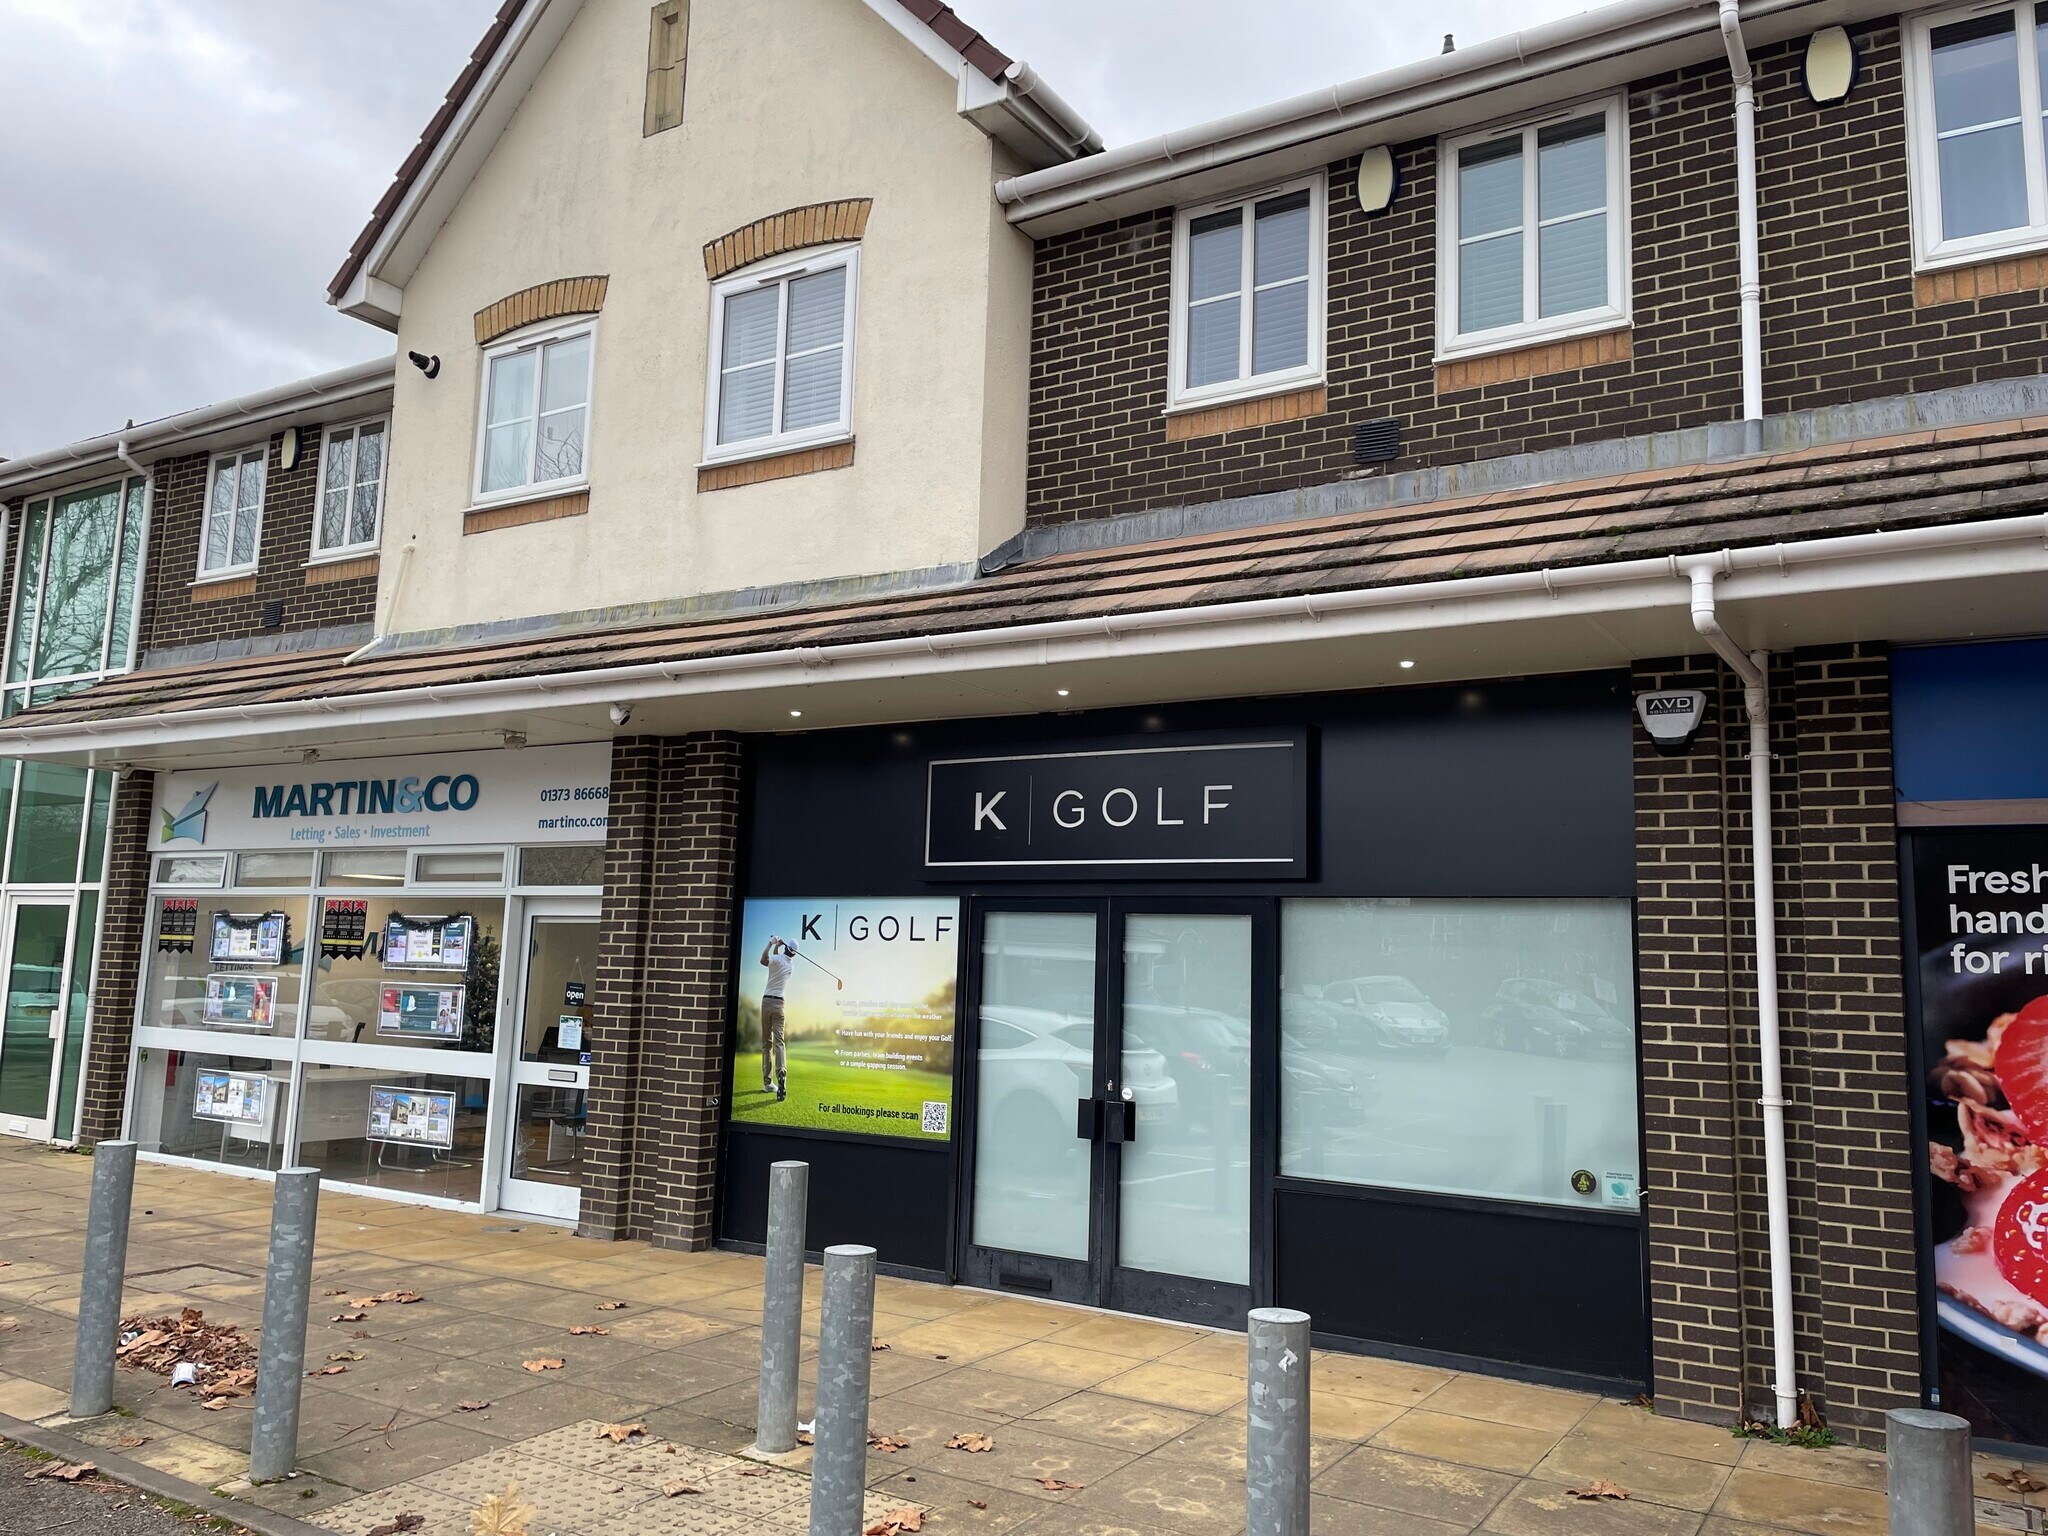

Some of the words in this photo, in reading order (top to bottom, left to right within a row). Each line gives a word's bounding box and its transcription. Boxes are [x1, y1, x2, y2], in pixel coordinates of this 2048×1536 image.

[1650, 698, 1691, 710] AVD
[251, 773, 480, 819] MARTIN&CO
[540, 788, 571, 802] 01373
[574, 786, 609, 801] 86668
[974, 790, 1007, 831] K
[1053, 784, 1233, 828] GOLF
[290, 826, 326, 843] Letting
[334, 825, 361, 839] Sales
[370, 824, 431, 838] Investment
[1947, 863, 2048, 894] Fresh
[1949, 903, 2048, 934] hand
[801, 914, 823, 941] K
[849, 915, 953, 942] GOLF
[1950, 943, 2010, 974] for
[566, 990, 584, 1000] open
[841, 1029, 853, 1037] Have
[863, 1030, 874, 1038] with
[886, 1031, 903, 1039] friends
[914, 1034, 928, 1042] enjoy
[840, 1049, 853, 1057] From
[885, 1052, 906, 1061] building
[850, 1060, 867, 1068] simple
[819, 1103, 830, 1113] For
[831, 1104, 841, 1113] all
[841, 1104, 875, 1118] bookings
[875, 1107, 900, 1119] please
[901, 1110, 919, 1120] scan
